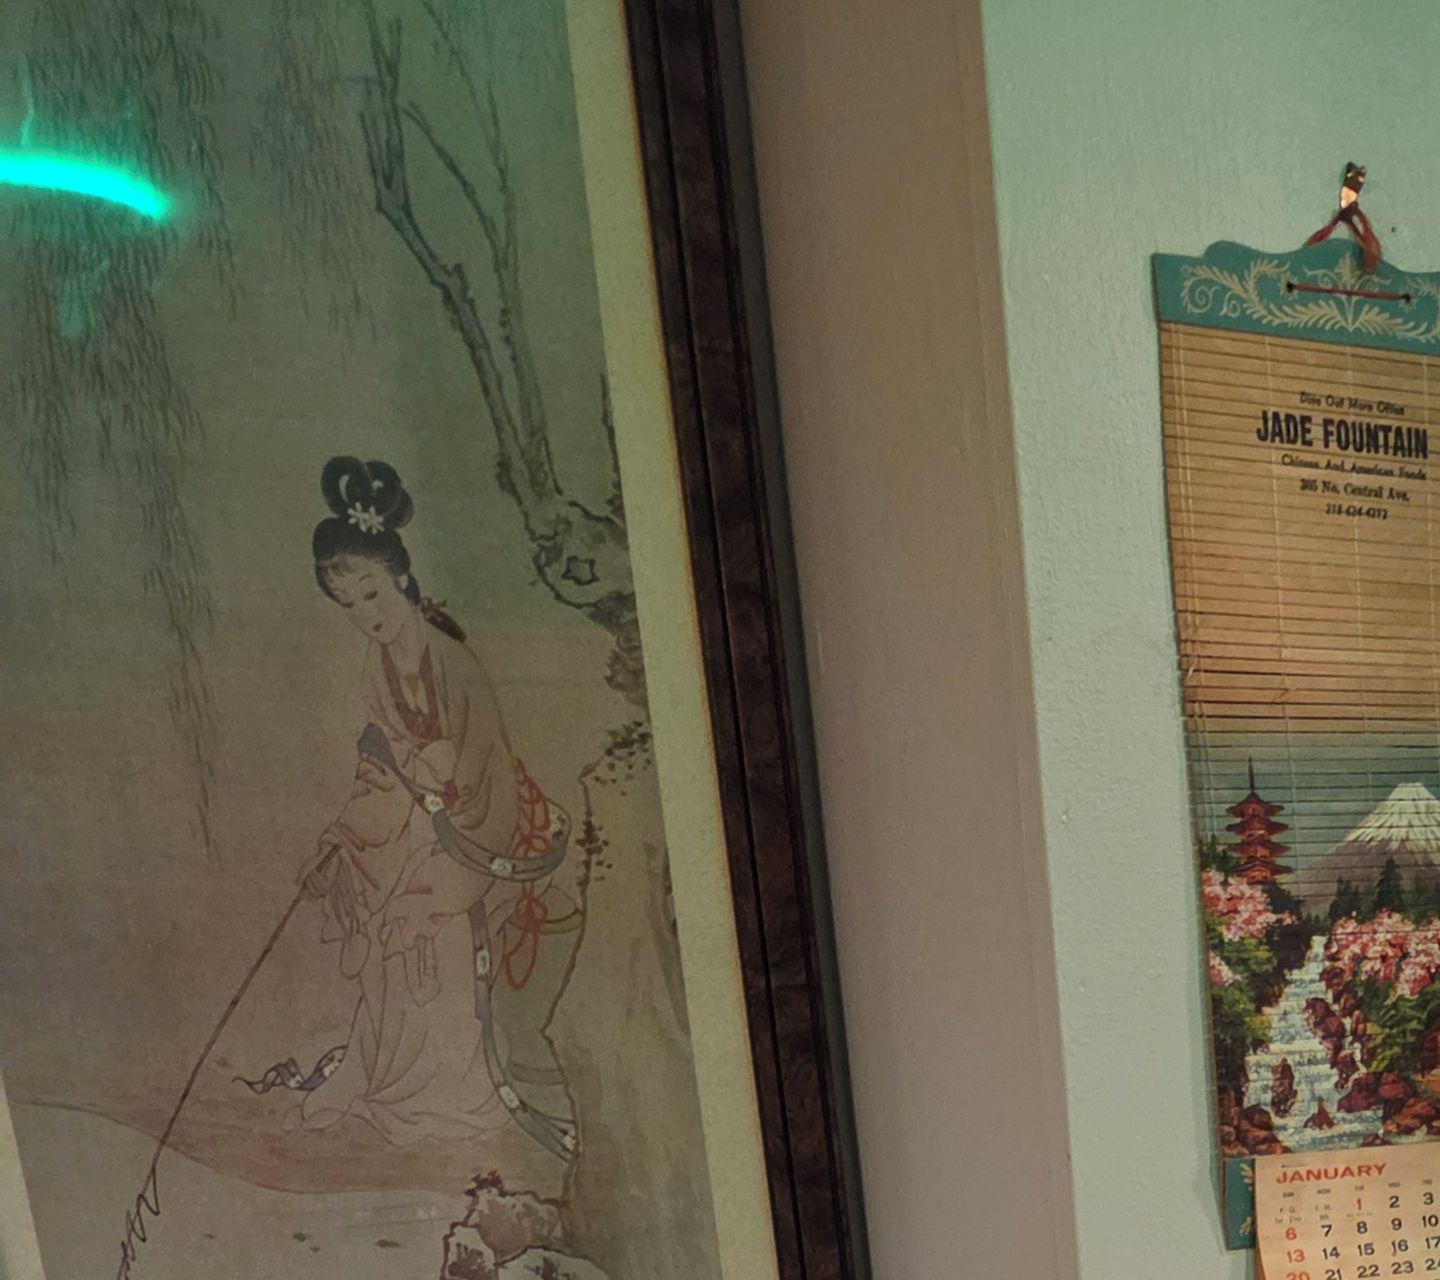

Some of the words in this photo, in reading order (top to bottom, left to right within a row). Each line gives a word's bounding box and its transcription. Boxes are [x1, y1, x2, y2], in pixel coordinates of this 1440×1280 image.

[1257, 410, 1313, 447] JADE
[1323, 418, 1428, 459] FOUNTAIN
[1325, 459, 1344, 472] And
[1351, 462, 1394, 477] American
[1344, 483, 1384, 499] Central
[1276, 1162, 1386, 1184] JANUARY
[1356, 1198, 1363, 1211] 1
[1388, 1195, 1400, 1209] 2
[1423, 1191, 1434, 1205] 3
[1285, 1227, 1297, 1241] 6
[1321, 1224, 1333, 1237] 7
[1356, 1220, 1368, 1234] 8
[1391, 1217, 1402, 1231] 9
[1422, 1214, 1439, 1228] 10
[1286, 1248, 1306, 1263] 13
[1322, 1246, 1340, 1260] 14
[1357, 1242, 1375, 1256] 15
[1391, 1239, 1409, 1254] 16
[1357, 1264, 1381, 1279] 22
[1391, 1260, 1414, 1275] 23
